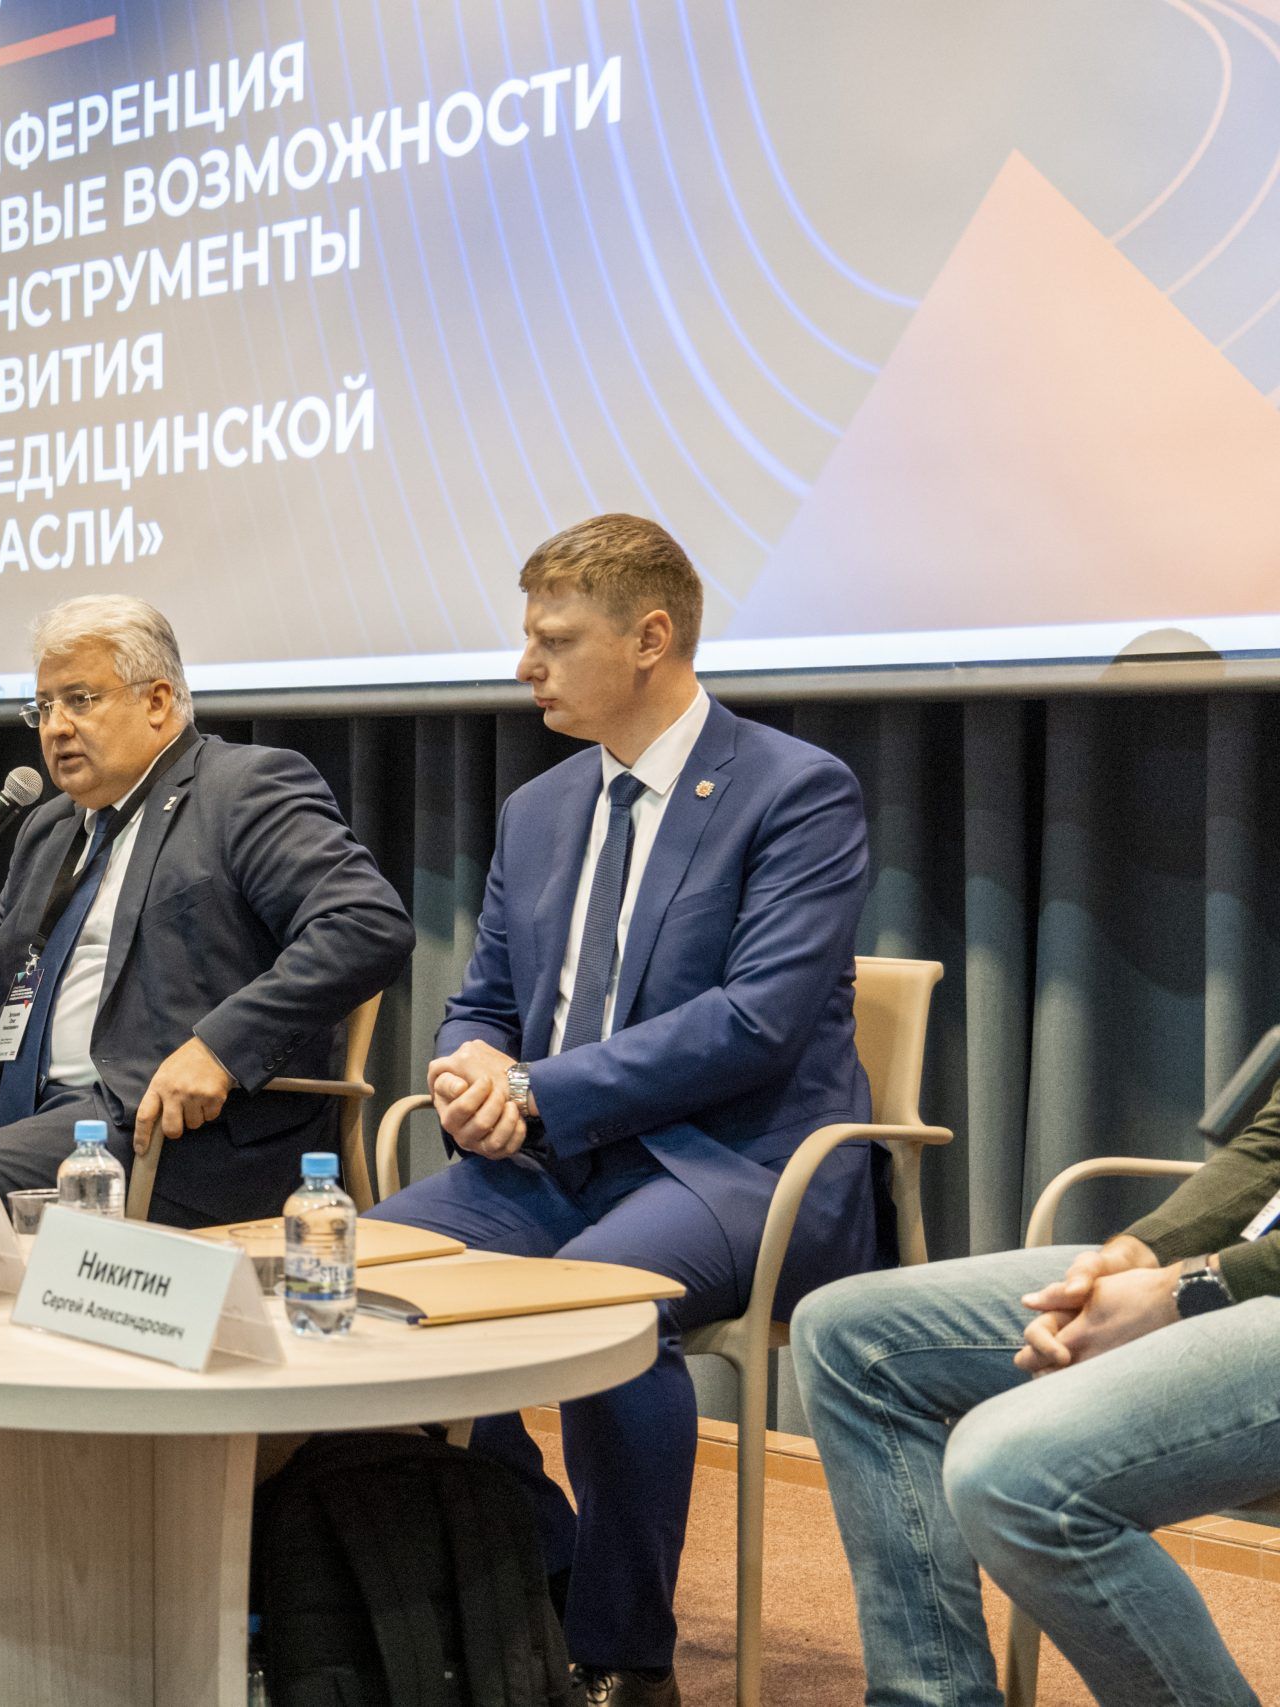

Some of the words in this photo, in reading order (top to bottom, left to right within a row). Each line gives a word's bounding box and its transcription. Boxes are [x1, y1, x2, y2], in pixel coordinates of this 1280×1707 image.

[122, 55, 623, 226] ВОЗМОЖНОСТИ
[77, 1249, 172, 1298] Никитин
[41, 1289, 85, 1313] Сергей
[84, 1301, 186, 1340] Александрович
